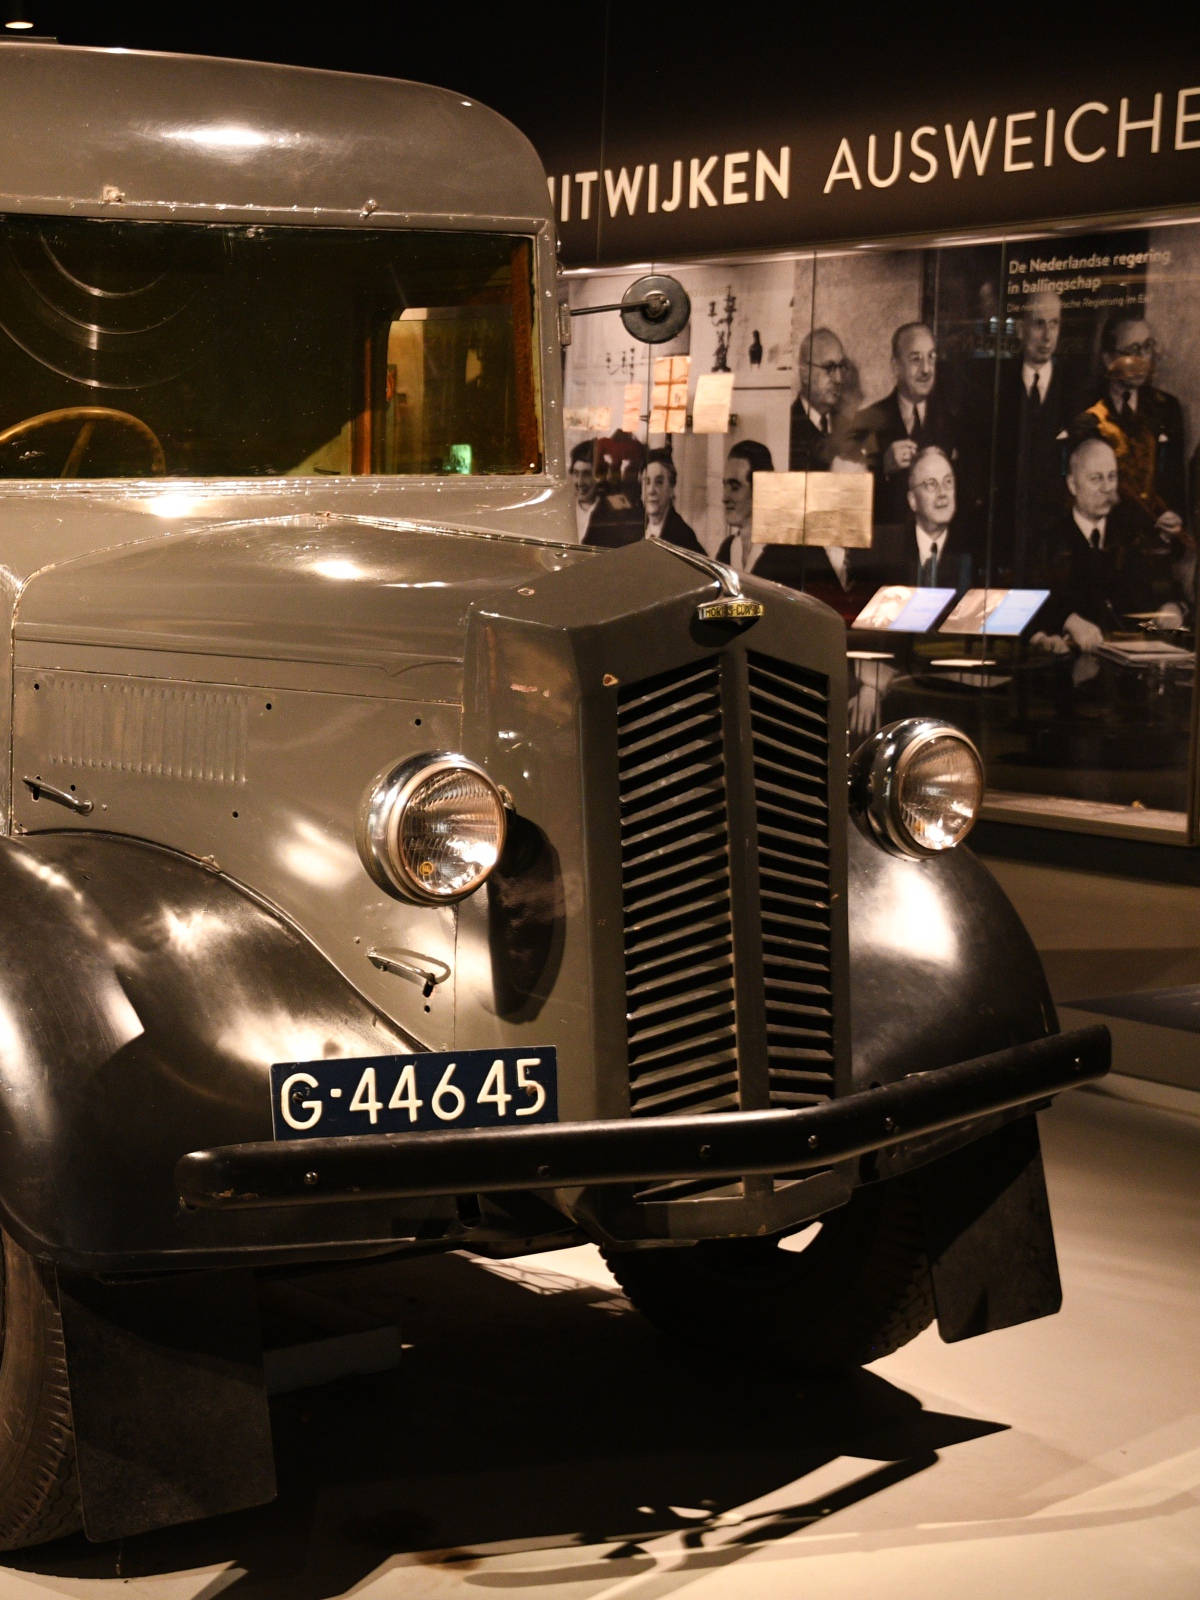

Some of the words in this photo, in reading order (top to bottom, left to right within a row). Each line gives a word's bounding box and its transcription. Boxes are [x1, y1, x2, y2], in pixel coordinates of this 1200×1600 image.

[548, 146, 790, 222] ITWIJKEN
[823, 86, 1200, 194] AUSWEICHE
[1009, 260, 1027, 274] De
[1029, 254, 1110, 272] Nederlandse
[1113, 247, 1172, 268] regering
[1007, 281, 1020, 294] in
[1022, 275, 1102, 294] ballingschap
[1083, 297, 1124, 309] Regierung
[280, 1058, 546, 1130] G-44645
